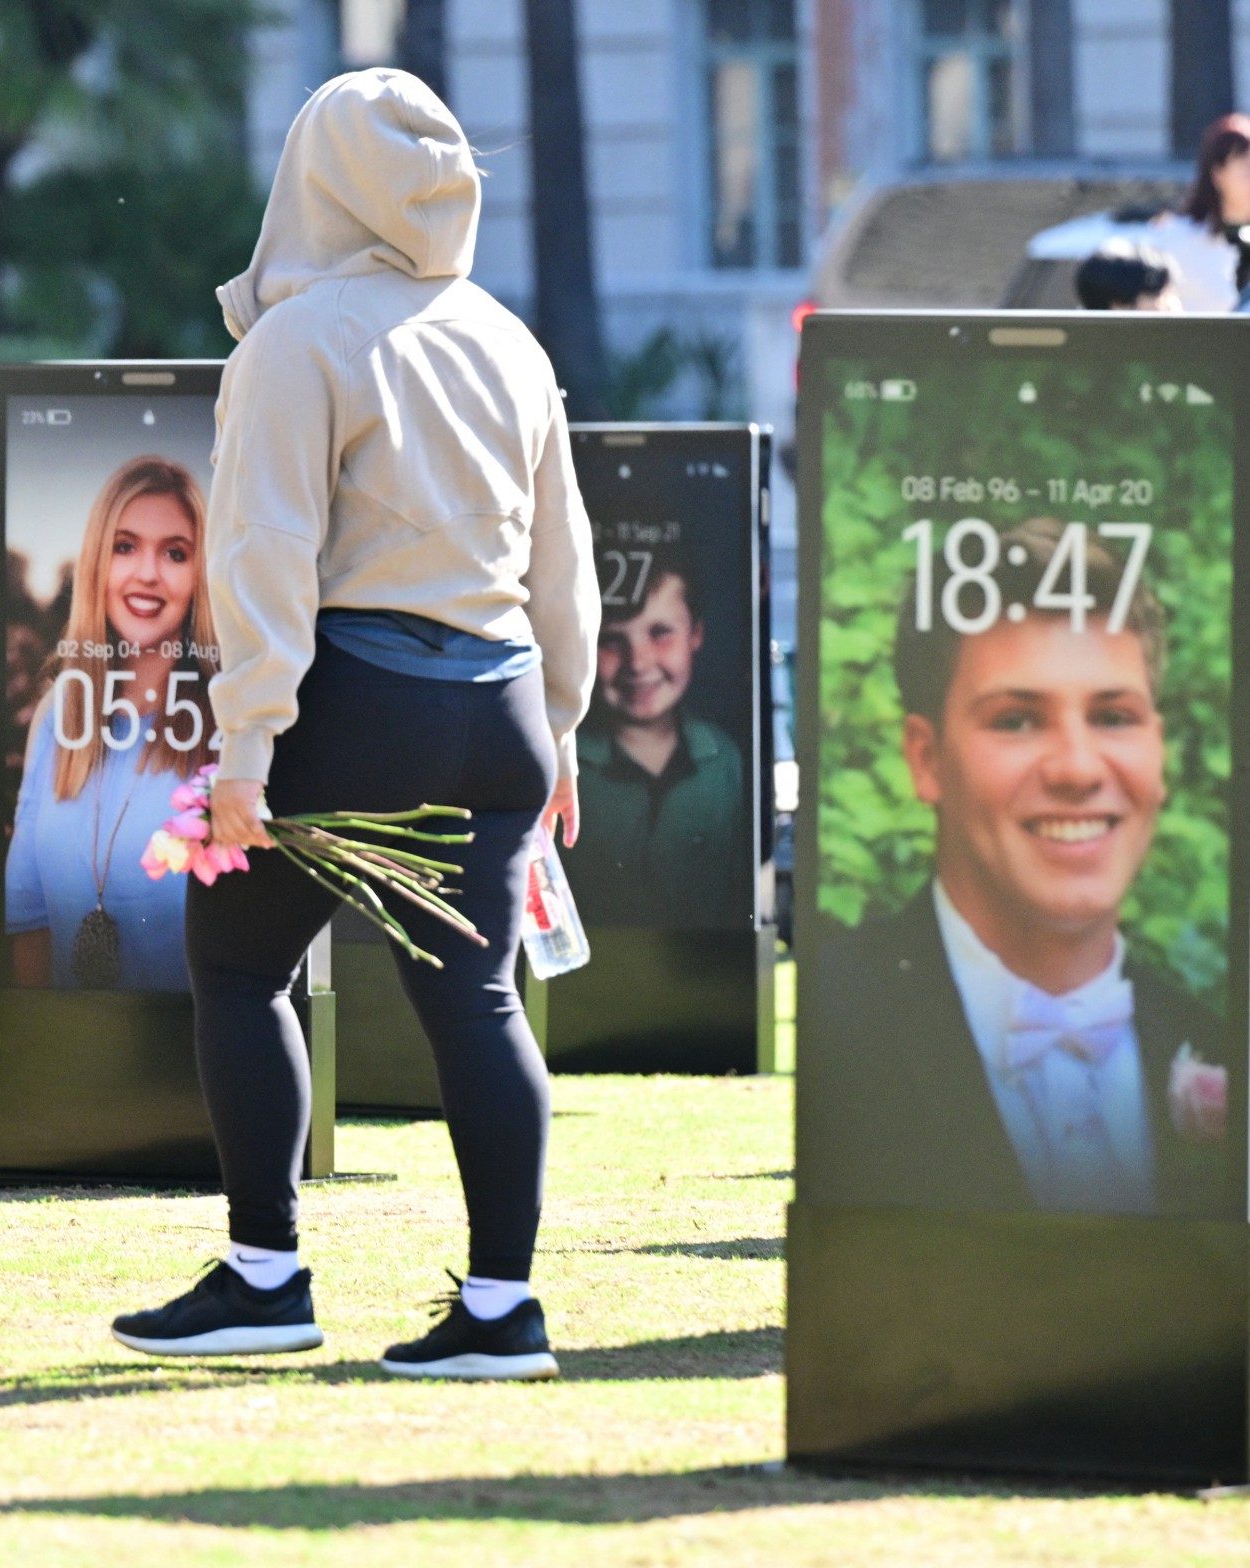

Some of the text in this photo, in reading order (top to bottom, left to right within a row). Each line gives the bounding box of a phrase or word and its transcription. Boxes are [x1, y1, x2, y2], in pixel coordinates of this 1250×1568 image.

[901, 476, 936, 501] 08
[940, 476, 984, 502] Feb
[988, 477, 1021, 502] 96
[1048, 478, 1067, 503] 11
[1073, 479, 1115, 508] Apr
[1119, 479, 1153, 506] 20
[901, 517, 1153, 636] 18:47
[56, 640, 79, 658] 02
[82, 640, 114, 661] Sep
[118, 641, 140, 658] 04
[160, 641, 183, 659] 08
[188, 643, 219, 662] Aug
[54, 668, 223, 751] 05:5
